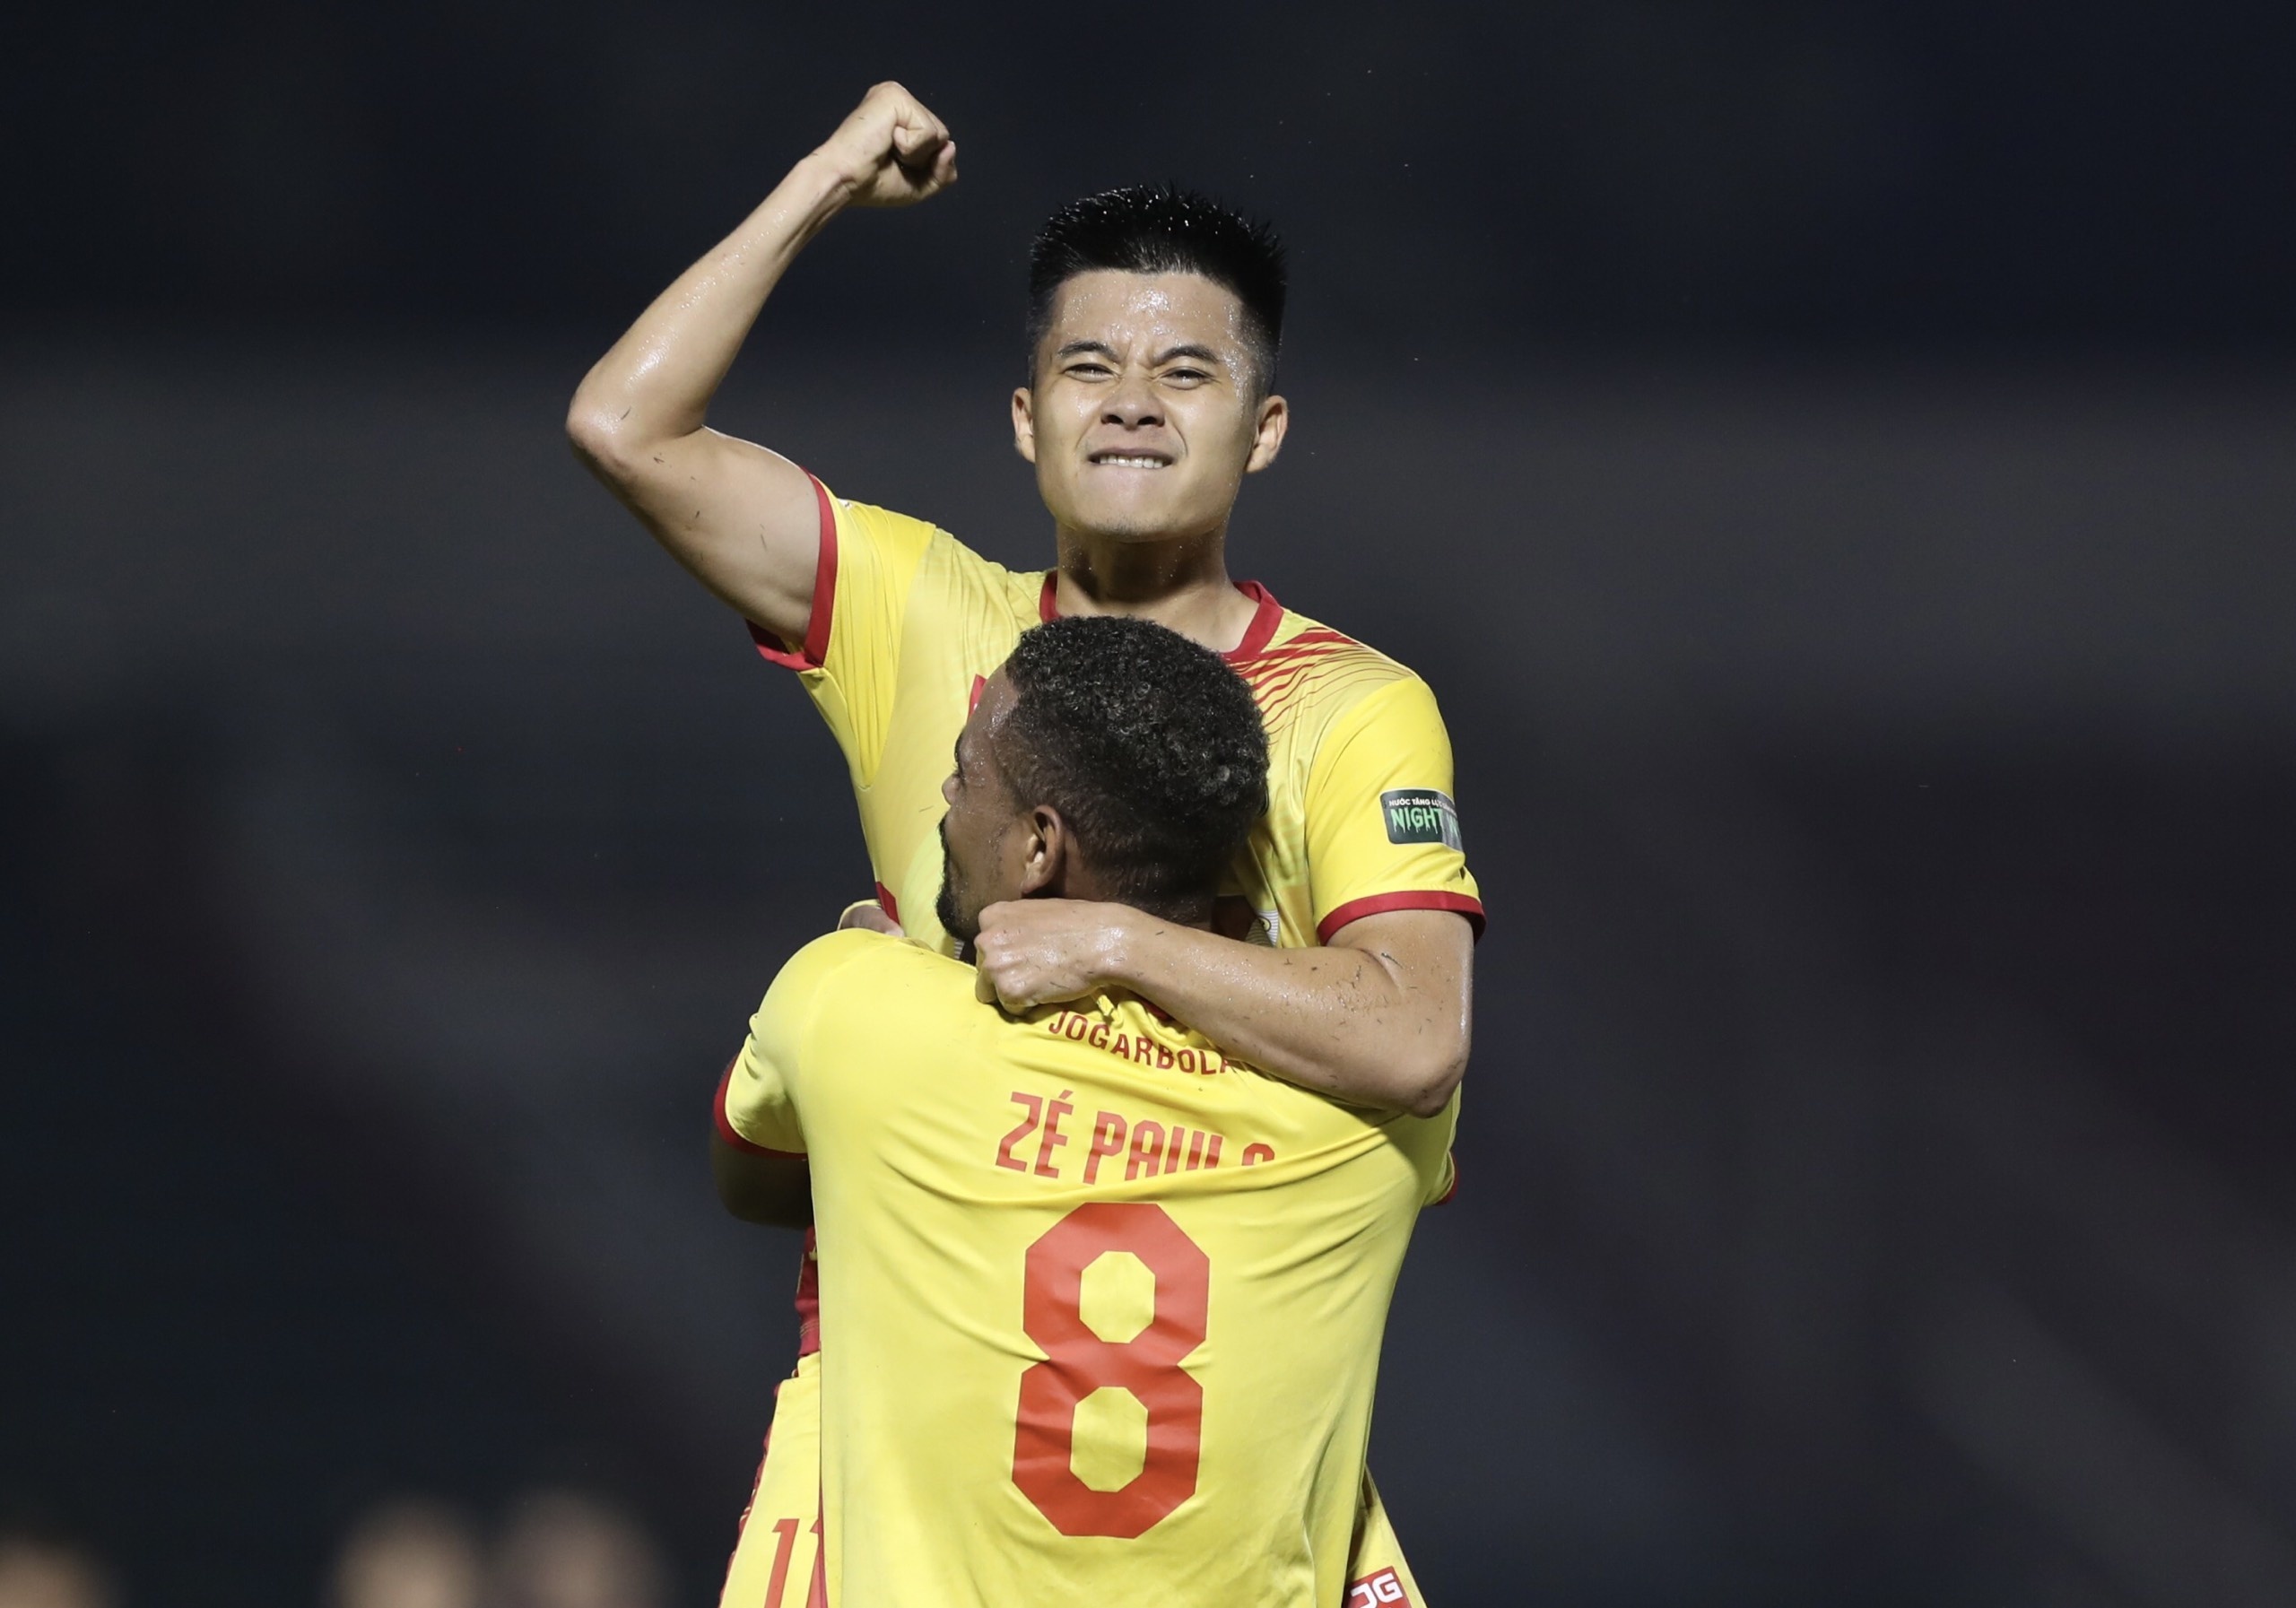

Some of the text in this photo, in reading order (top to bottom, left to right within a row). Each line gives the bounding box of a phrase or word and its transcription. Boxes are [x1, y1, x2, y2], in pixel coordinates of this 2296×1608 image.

[1390, 806, 1445, 834] NIGHT
[1412, 796, 1431, 805] TĂNG
[996, 1090, 1074, 1178] ZÉ
[1012, 1202, 1210, 1539] 8
